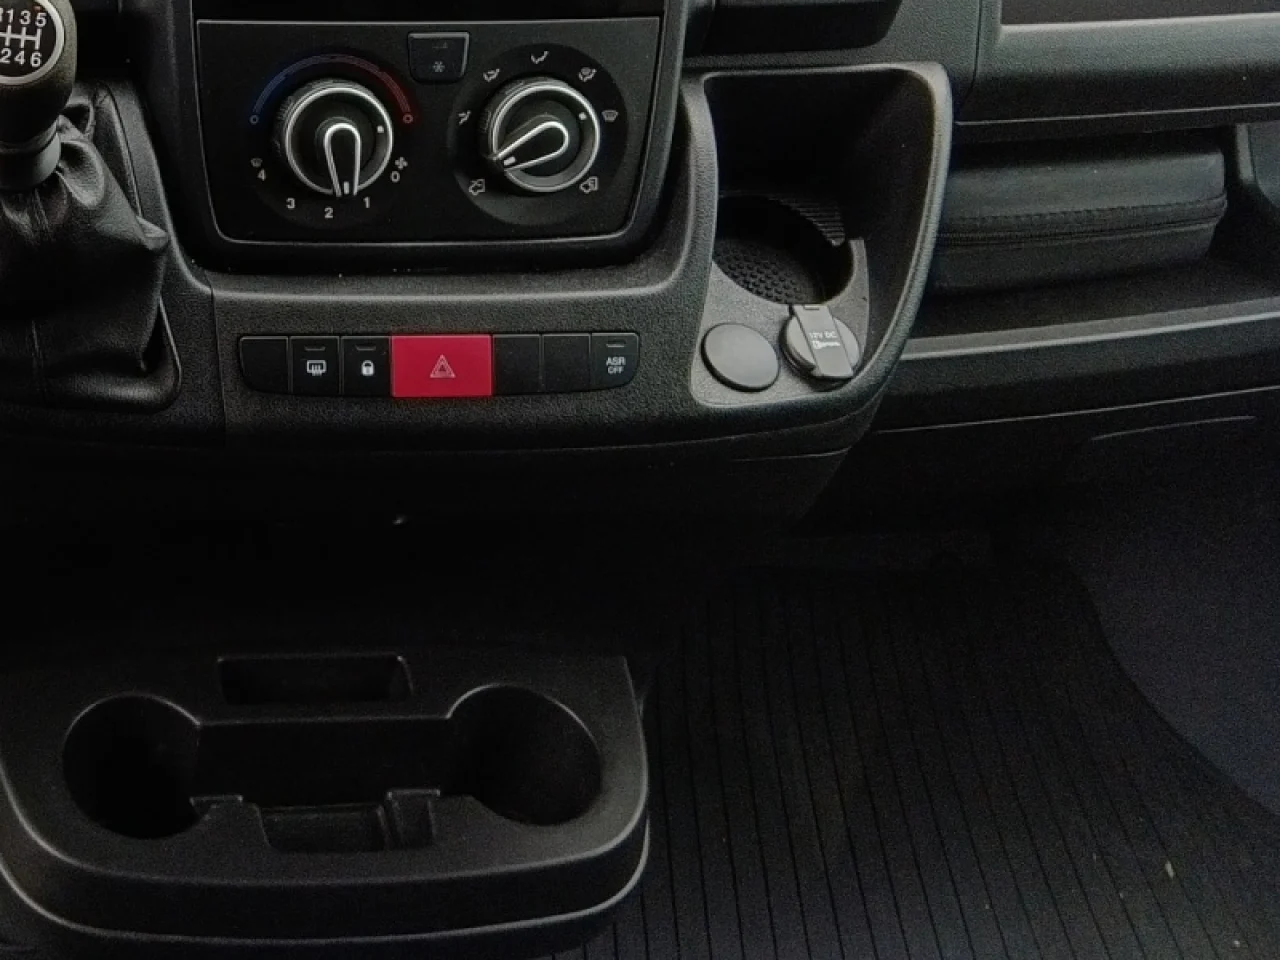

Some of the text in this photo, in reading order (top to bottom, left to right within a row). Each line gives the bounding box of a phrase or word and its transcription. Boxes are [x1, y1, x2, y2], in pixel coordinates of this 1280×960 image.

[6, 8, 14, 22] 1
[19, 10, 31, 25] 3
[35, 12, 47, 27] 5
[0, 48, 42, 67] 2 4 6
[257, 168, 267, 181] 4
[286, 197, 295, 209] 3
[363, 196, 370, 209] 1
[324, 207, 334, 219] 2
[606, 356, 626, 366] ASR
[608, 365, 624, 374] OFF
